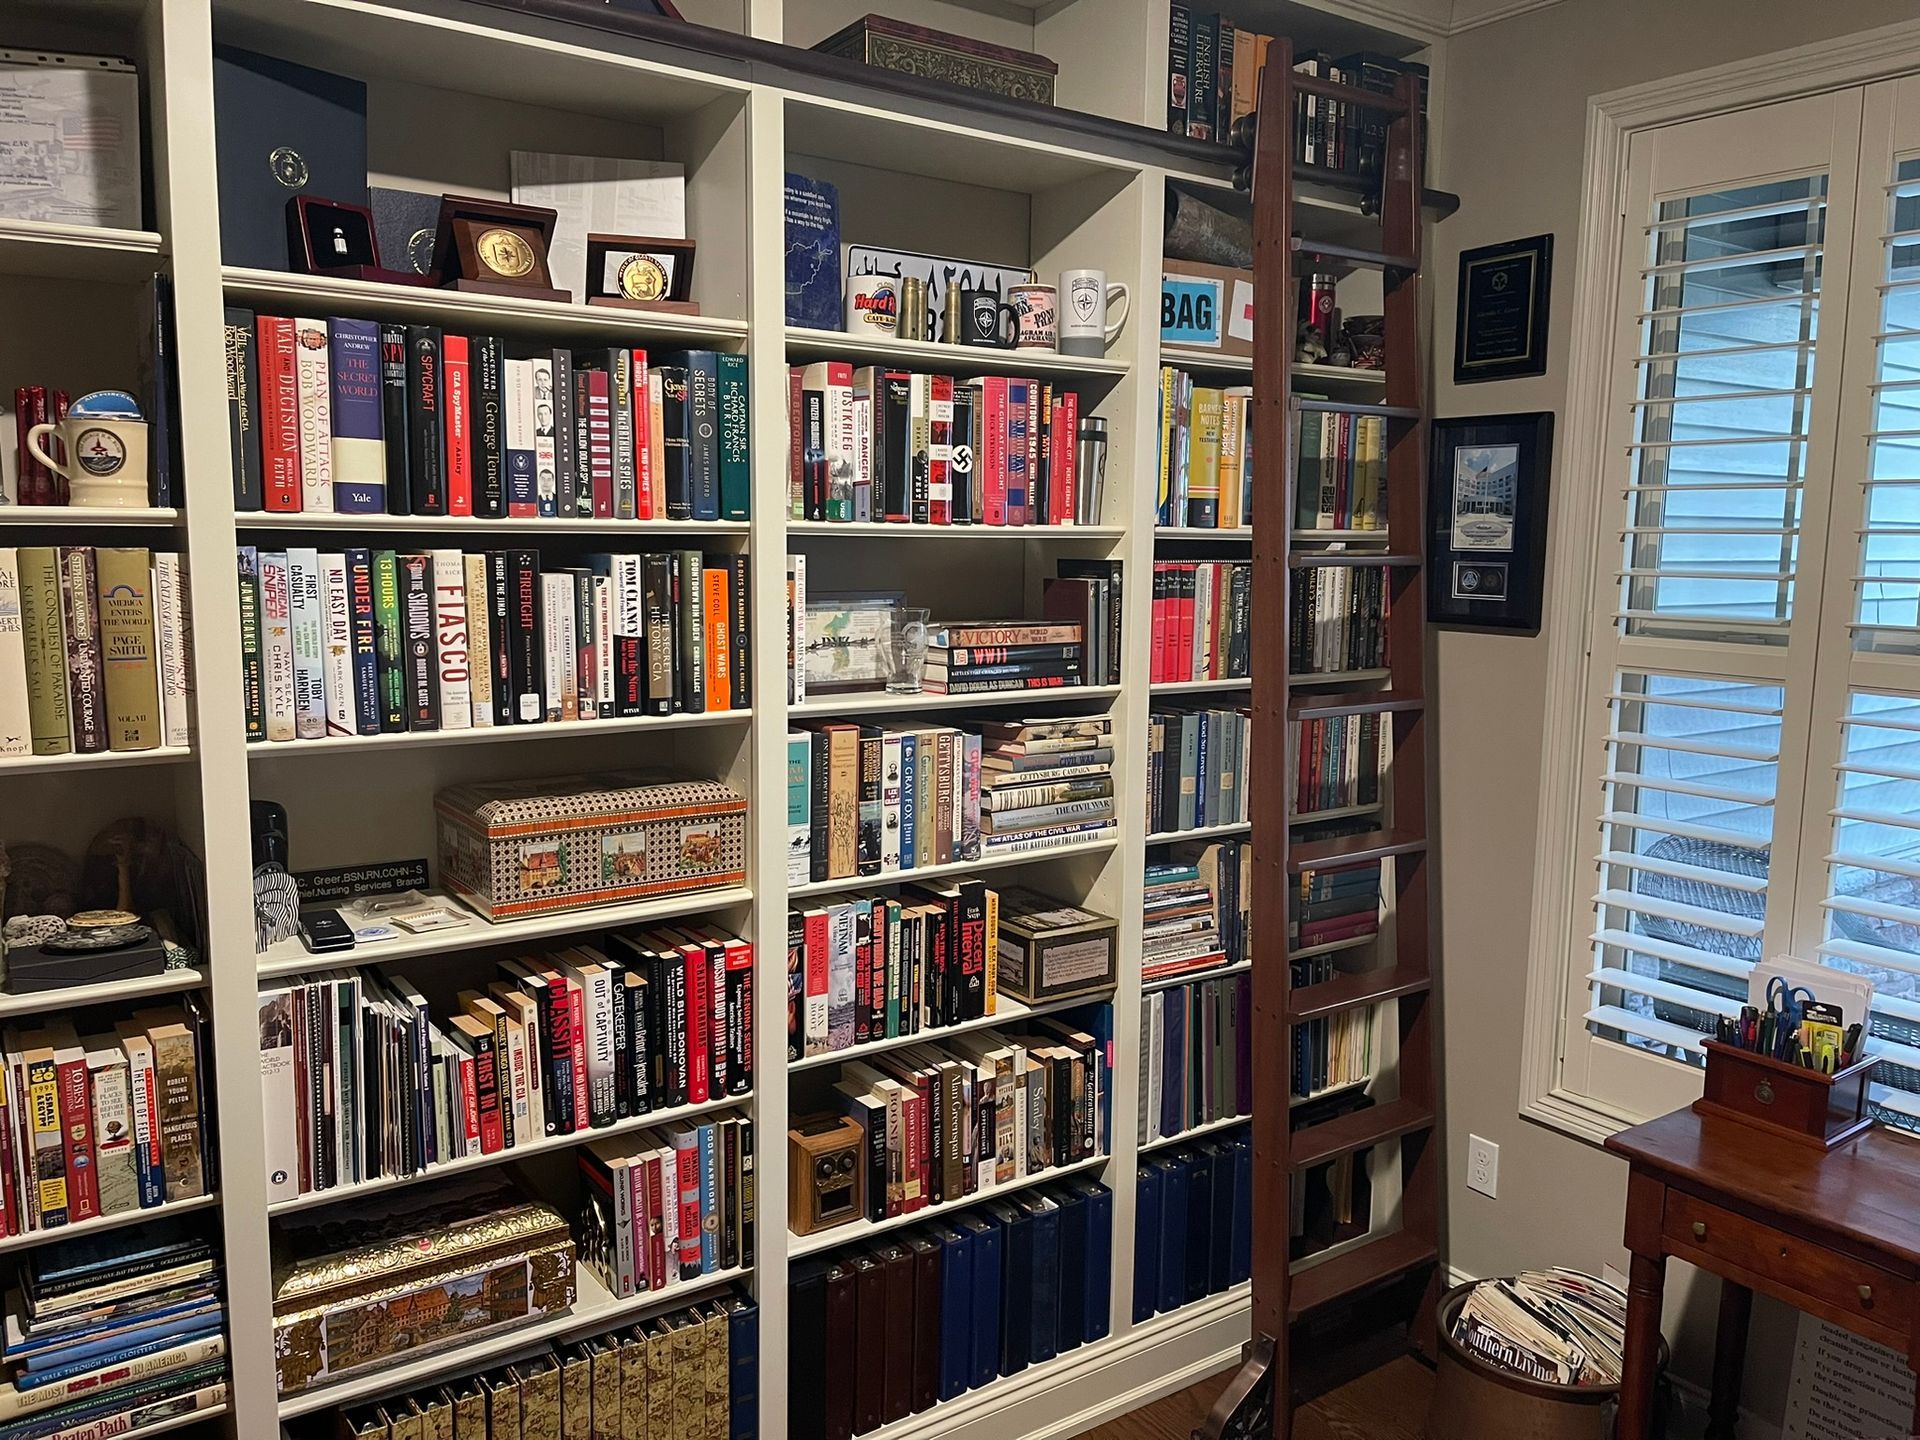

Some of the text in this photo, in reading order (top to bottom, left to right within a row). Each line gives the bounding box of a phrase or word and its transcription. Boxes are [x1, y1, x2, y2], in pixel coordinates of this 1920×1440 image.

[1195, 34, 1204, 104] LITERATURE
[1203, 36, 1211, 89] ENGLISH
[855, 293, 887, 310] Hard
[1161, 293, 1212, 330] BAG
[337, 372, 377, 384] SECRET
[346, 358, 369, 369] THE
[421, 355, 434, 412] SPYCRAFT
[338, 385, 377, 397] WORLD
[694, 369, 706, 417] SECRETS
[1198, 403, 1221, 413] BARNES
[301, 360, 317, 487] BOB WOODWARD
[315, 362, 330, 487] PLAN OF ATTACK
[723, 394, 732, 450] BURTON
[842, 391, 853, 451] OSTKRIEG
[1200, 415, 1220, 425] NOTES
[483, 402, 500, 489] George Tenet
[861, 436, 869, 480] DANGER
[1221, 432, 1229, 457] Bible
[352, 493, 371, 502] Yale
[264, 565, 278, 620] SNIPER
[276, 566, 288, 619] AMERICAN
[290, 565, 305, 610] CASUALTY
[305, 574, 317, 600] FIRST
[329, 569, 347, 641] NO EASY DAY
[380, 559, 394, 609] 13 HOURS
[495, 557, 506, 617] INSIDE THE JIHAD
[519, 570, 534, 629] FIREFIGHT
[625, 560, 638, 635] TOM CLANCY
[120, 618, 150, 626] WORLD
[240, 581, 256, 653] JAWBREAKER
[353, 565, 373, 654] UNDER FIRE
[24, 586, 42, 699] KIRKPATRICK SALE
[43, 566, 64, 720] THE CONQUEST OF PARADISE
[109, 645, 146, 656] SMITH
[112, 636, 142, 645] PAGE
[437, 585, 468, 683] FIASCO
[651, 606, 662, 681] HISTORY CIA
[661, 613, 671, 673] THE SECRET
[716, 622, 726, 678] GHOST WARS
[964, 630, 1021, 644] VICTORY
[973, 648, 1007, 665] WWII
[273, 645, 284, 717] CHRIS KYLE
[296, 669, 310, 711] HARNDEN
[311, 677, 322, 700] TOBY
[949, 680, 1024, 693] DAVID DOUGLAS DUNCAN
[1201, 740, 1206, 750] So
[938, 735, 950, 803] GETTYSBURG
[1020, 767, 1090, 781] GETTYSBURG CAMPAIGN
[1002, 833, 1023, 842] ATLAS
[1024, 832, 1033, 840] OF
[1034, 830, 1047, 838] THE
[1048, 827, 1065, 836] CIVIL
[1066, 825, 1081, 833] WAR
[354, 880, 392, 891] Services
[396, 876, 425, 886] Branch
[839, 910, 848, 955] VIETNAM
[962, 922, 974, 975] Interval
[614, 983, 626, 1051] GATEKEEPER
[677, 1000, 685, 1029] BILL
[167, 1077, 188, 1086] ROBERT
[477, 1051, 496, 1110] FIRST IN
[513, 1048, 526, 1100] INSIDE THE CIA
[678, 1031, 686, 1088] DONOVAN
[34, 1084, 55, 1094] 1995
[45, 1093, 55, 1126] ISRAEL
[133, 1069, 148, 1143] THE GIFT OF FEAR
[168, 1096, 189, 1104] PELTON
[1032, 1087, 1044, 1131] Stanley
[164, 1121, 198, 1134] DANGEROUS
[949, 1073, 961, 1160] Alan Greenspan
[171, 1134, 192, 1144] PLACES
[682, 1156, 690, 1184] STATION
[708, 1157, 716, 1212] WARRIORS
[42, 1370, 62, 1382] WALK
[65, 1359, 101, 1374] THROUGH
[104, 1355, 118, 1364] THE
[119, 1344, 157, 1360] CLOISTERS
[1468, 1327, 1554, 1381] outhern Living
[1826, 1352, 1841, 1363] you
[1844, 1360, 1864, 1373] drop
[1874, 1373, 1907, 1392] weapon
[1810, 1396, 1820, 1404] on
[1823, 1400, 1835, 1411] the
[1814, 1371, 1855, 1395] the range.
[94, 1415, 128, 1437] Path
